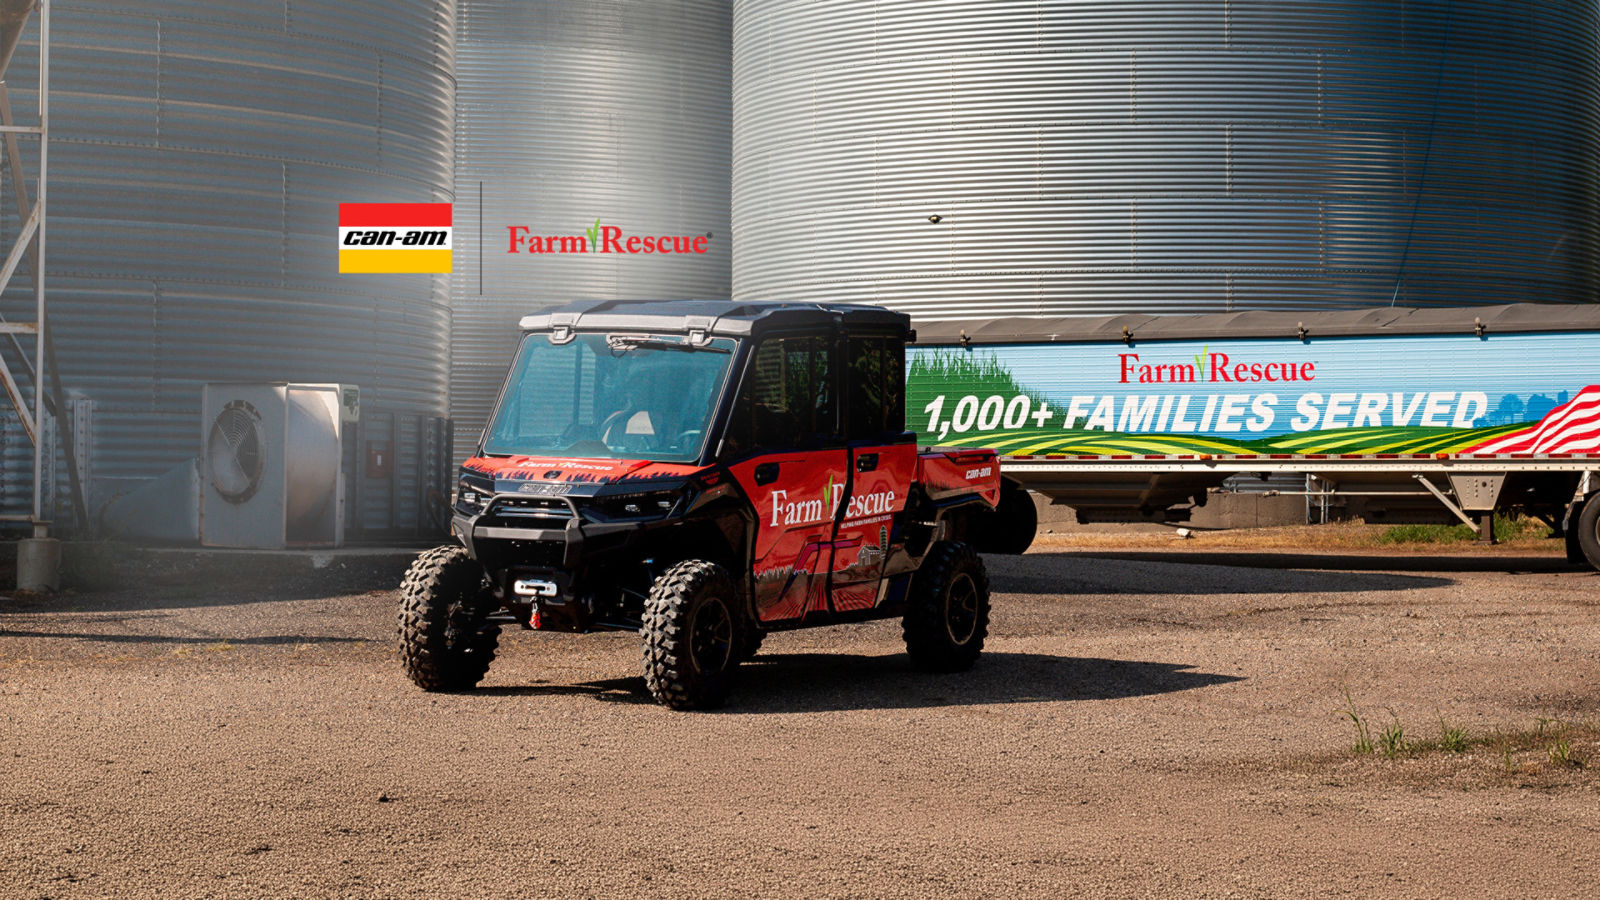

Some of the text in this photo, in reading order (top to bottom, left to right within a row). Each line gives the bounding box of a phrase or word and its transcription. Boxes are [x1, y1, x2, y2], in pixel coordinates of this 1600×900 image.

[1117, 352, 1316, 384] Farm Rescue
[924, 390, 1489, 441] 1,000+ FAMILIES SERVED
[769, 489, 823, 527] Farm
